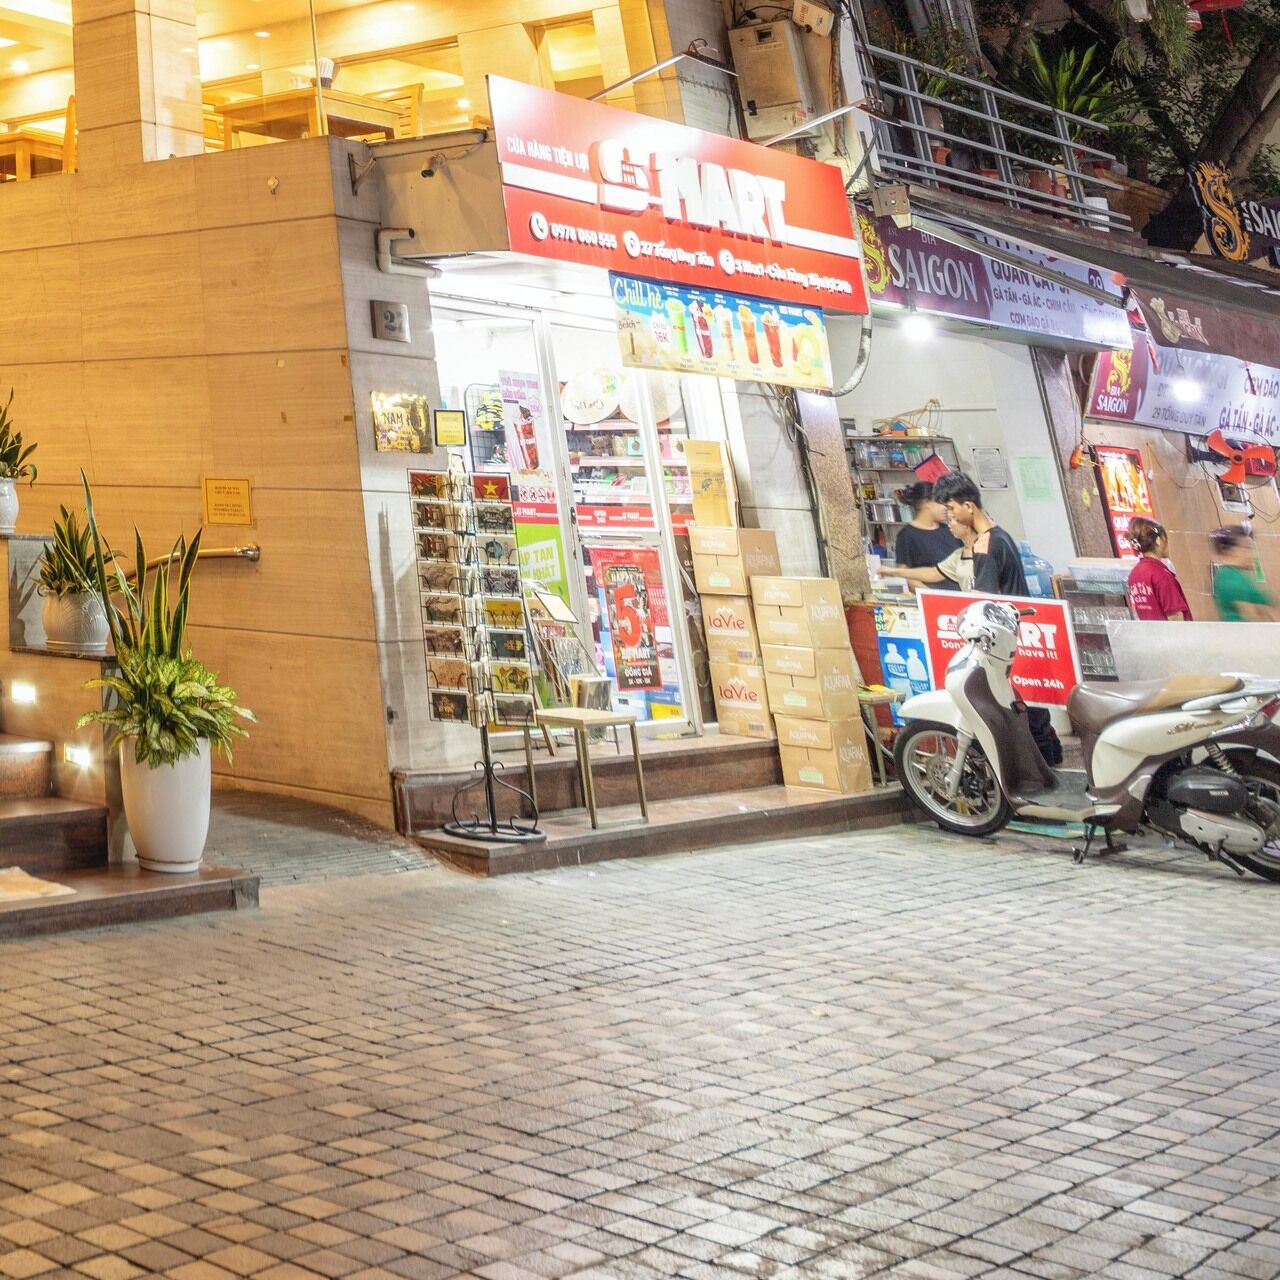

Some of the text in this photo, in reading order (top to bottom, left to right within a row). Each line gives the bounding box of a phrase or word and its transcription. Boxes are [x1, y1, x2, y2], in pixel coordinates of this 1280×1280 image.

[527, 139, 552, 161] HÀNG
[920, 231, 937, 246] BIA
[887, 243, 978, 303] SAIGON
[613, 277, 647, 308] Chill
[1110, 385, 1122, 396] BIA
[1096, 394, 1129, 414] SAIGON
[1018, 647, 1043, 659] have
[1012, 674, 1065, 690] Open 24h
